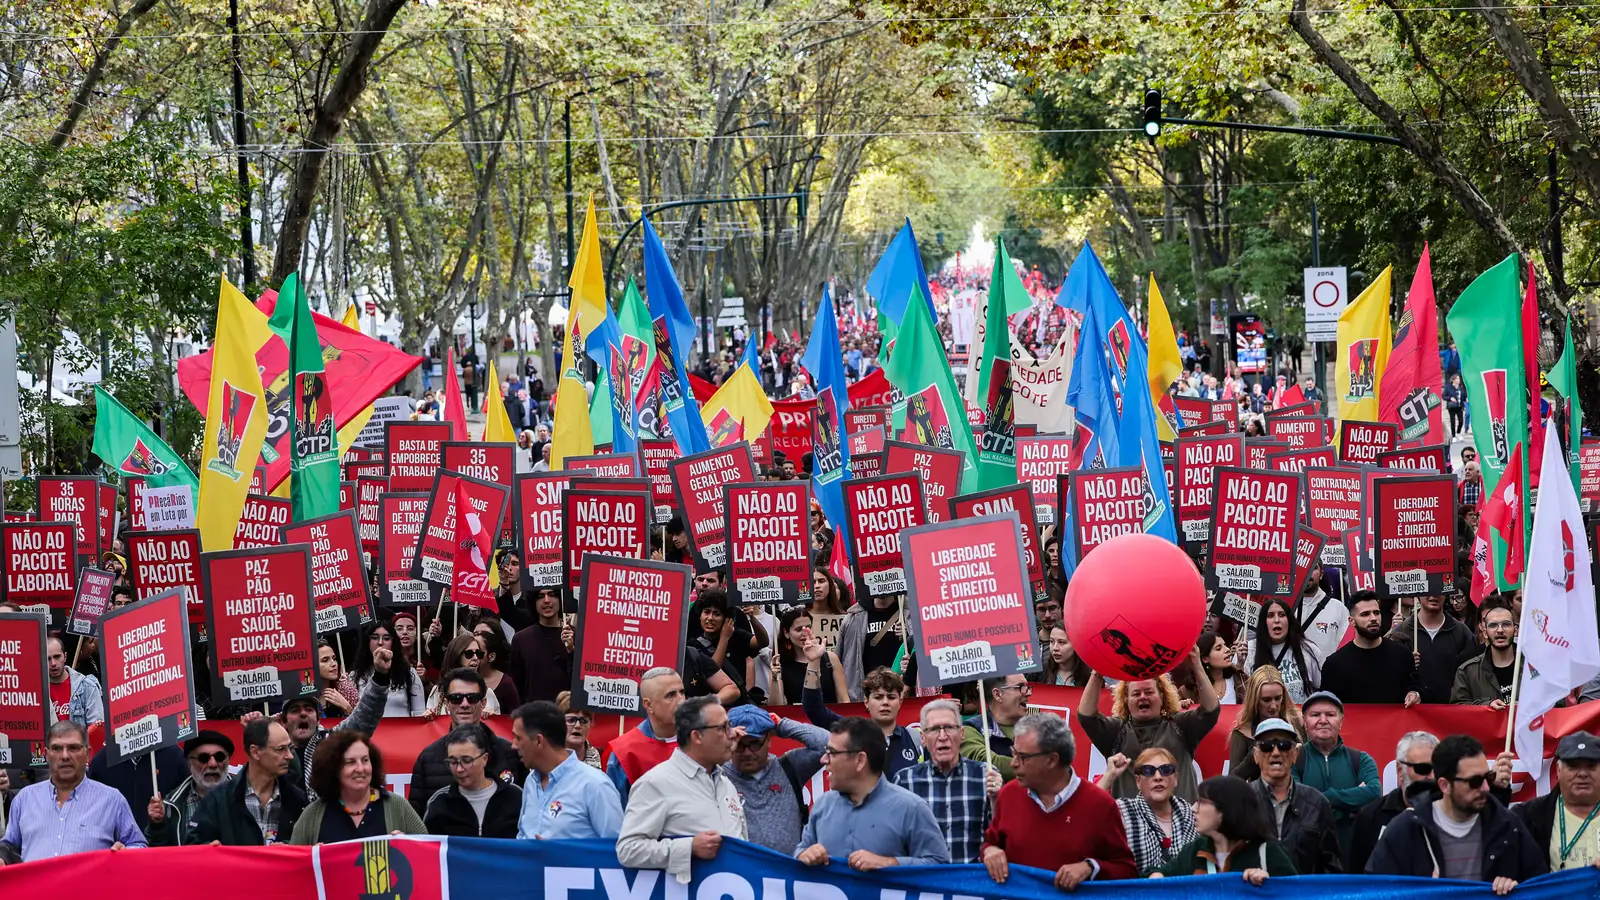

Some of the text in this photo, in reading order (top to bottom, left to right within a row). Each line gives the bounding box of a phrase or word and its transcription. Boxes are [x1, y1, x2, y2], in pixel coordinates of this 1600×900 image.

[1012, 360, 1062, 384] IEDADE
[854, 414, 876, 424] DIREITO
[1276, 422, 1315, 434] AUMENTO
[1350, 427, 1388, 444] NÃO AO
[400, 440, 438, 451] BASTA DE
[855, 436, 865, 444] PAZ
[1288, 436, 1304, 446] DAS
[392, 453, 440, 464] EMPOBRECE
[470, 448, 486, 464] 35
[914, 453, 932, 466] PAZ
[1023, 442, 1068, 460] NÃO AO
[1186, 444, 1234, 465] NÃO AO
[1251, 448, 1266, 458] PAZ
[1348, 444, 1389, 458] PACOTE
[390, 466, 437, 476] A TRABALH
[689, 454, 734, 476] AUMENTO
[1022, 461, 1070, 477] PACOTE
[1251, 459, 1266, 470] PÃO
[458, 466, 499, 481] HORAS
[690, 468, 740, 491] GERAL DOS
[60, 482, 74, 496] 35
[1084, 476, 1141, 500] NÃO AO
[1227, 476, 1288, 504] NÃO AO
[1311, 478, 1360, 490] CONTRATAÇÃO
[50, 497, 85, 512] HORAS
[738, 490, 798, 514] NÃO AO
[856, 484, 912, 510] NÃO AO
[1310, 490, 1346, 502] COLETIVA,
[1394, 497, 1438, 510] LIBERDADE
[400, 500, 411, 512] UM
[577, 498, 636, 522] NÃO AO
[1085, 500, 1144, 522] PACOTE
[1315, 508, 1360, 521] CADUCIDADE,
[150, 508, 188, 522] em Luta por
[269, 506, 288, 524] AO
[392, 512, 403, 522] DE
[858, 506, 917, 534] PACOTE
[1224, 503, 1286, 528] PACOTE
[1398, 510, 1436, 522] SINDICAL
[236, 522, 280, 543] PACOT
[310, 525, 328, 540] PAZ
[738, 516, 800, 538] PACOTE
[1398, 522, 1436, 536] É DIREITO
[12, 530, 65, 550] NÃO AO
[313, 537, 331, 553] PÃO
[576, 526, 637, 548] PACOTE
[1216, 528, 1290, 552] LABORAL
[1382, 536, 1451, 550] CONSTITUCIONAL
[137, 539, 190, 562] NÃO AO
[734, 540, 806, 562] LABORAL
[931, 542, 997, 567] LIBERDADE
[12, 552, 66, 572] PACOTE
[246, 559, 270, 576] PAZ
[139, 562, 194, 584] PACOTE
[312, 564, 342, 583] SAÚDE
[609, 568, 663, 588] UM POSTO
[874, 572, 899, 583] SALÁRIO
[939, 562, 994, 583] SINDICAL
[1226, 567, 1254, 578] SALÁRIO
[1395, 573, 1420, 582] SALÁRIO
[8, 573, 73, 592] LABORAL
[246, 576, 271, 595] PÃO
[312, 578, 352, 598] DUCAÇÃO
[398, 582, 422, 591] SALÁRIO
[748, 580, 774, 590] SALÁRIO
[878, 582, 904, 592] DIREITOS
[941, 578, 998, 600] É DIREITO
[1228, 578, 1258, 588] DIREITOS
[1398, 583, 1425, 592] DIREITOS
[400, 592, 426, 600] DIREITOS
[598, 584, 670, 606] DE TRABALHO
[750, 590, 780, 600] DIREITOS
[226, 592, 294, 618] HABITAÇÃO
[597, 600, 669, 621] PERMANENTE
[922, 592, 1022, 621] CONSTITUCIONAL
[242, 610, 282, 633] SAÚDE
[118, 619, 166, 649] LIBERDADE
[231, 630, 296, 653] EDUCAÇÃO
[608, 631, 653, 650] VÍNCULO
[928, 632, 952, 646] OUTRO
[954, 630, 977, 642] RUMO
[985, 622, 1023, 638] POSSÍVEL!
[124, 638, 164, 663] SINDICAL
[604, 648, 654, 668] EFECTIVO
[945, 647, 983, 663] SALÁRIO
[124, 654, 166, 680] É DIREITO
[951, 660, 991, 675] DIREITOS
[1018, 660, 1034, 668] CGTP
[110, 664, 184, 702] CONSTITUCIONAL
[238, 671, 270, 685] SALÁRIO
[242, 684, 278, 697] DIREITOS
[596, 682, 630, 694] SALÁRIO
[599, 694, 634, 708] DIREITOS
[114, 712, 131, 724] OUTRO
[126, 720, 153, 739] SALÁRIO
[178, 727, 192, 736] CGTP
[129, 732, 158, 750] DIREITOS
